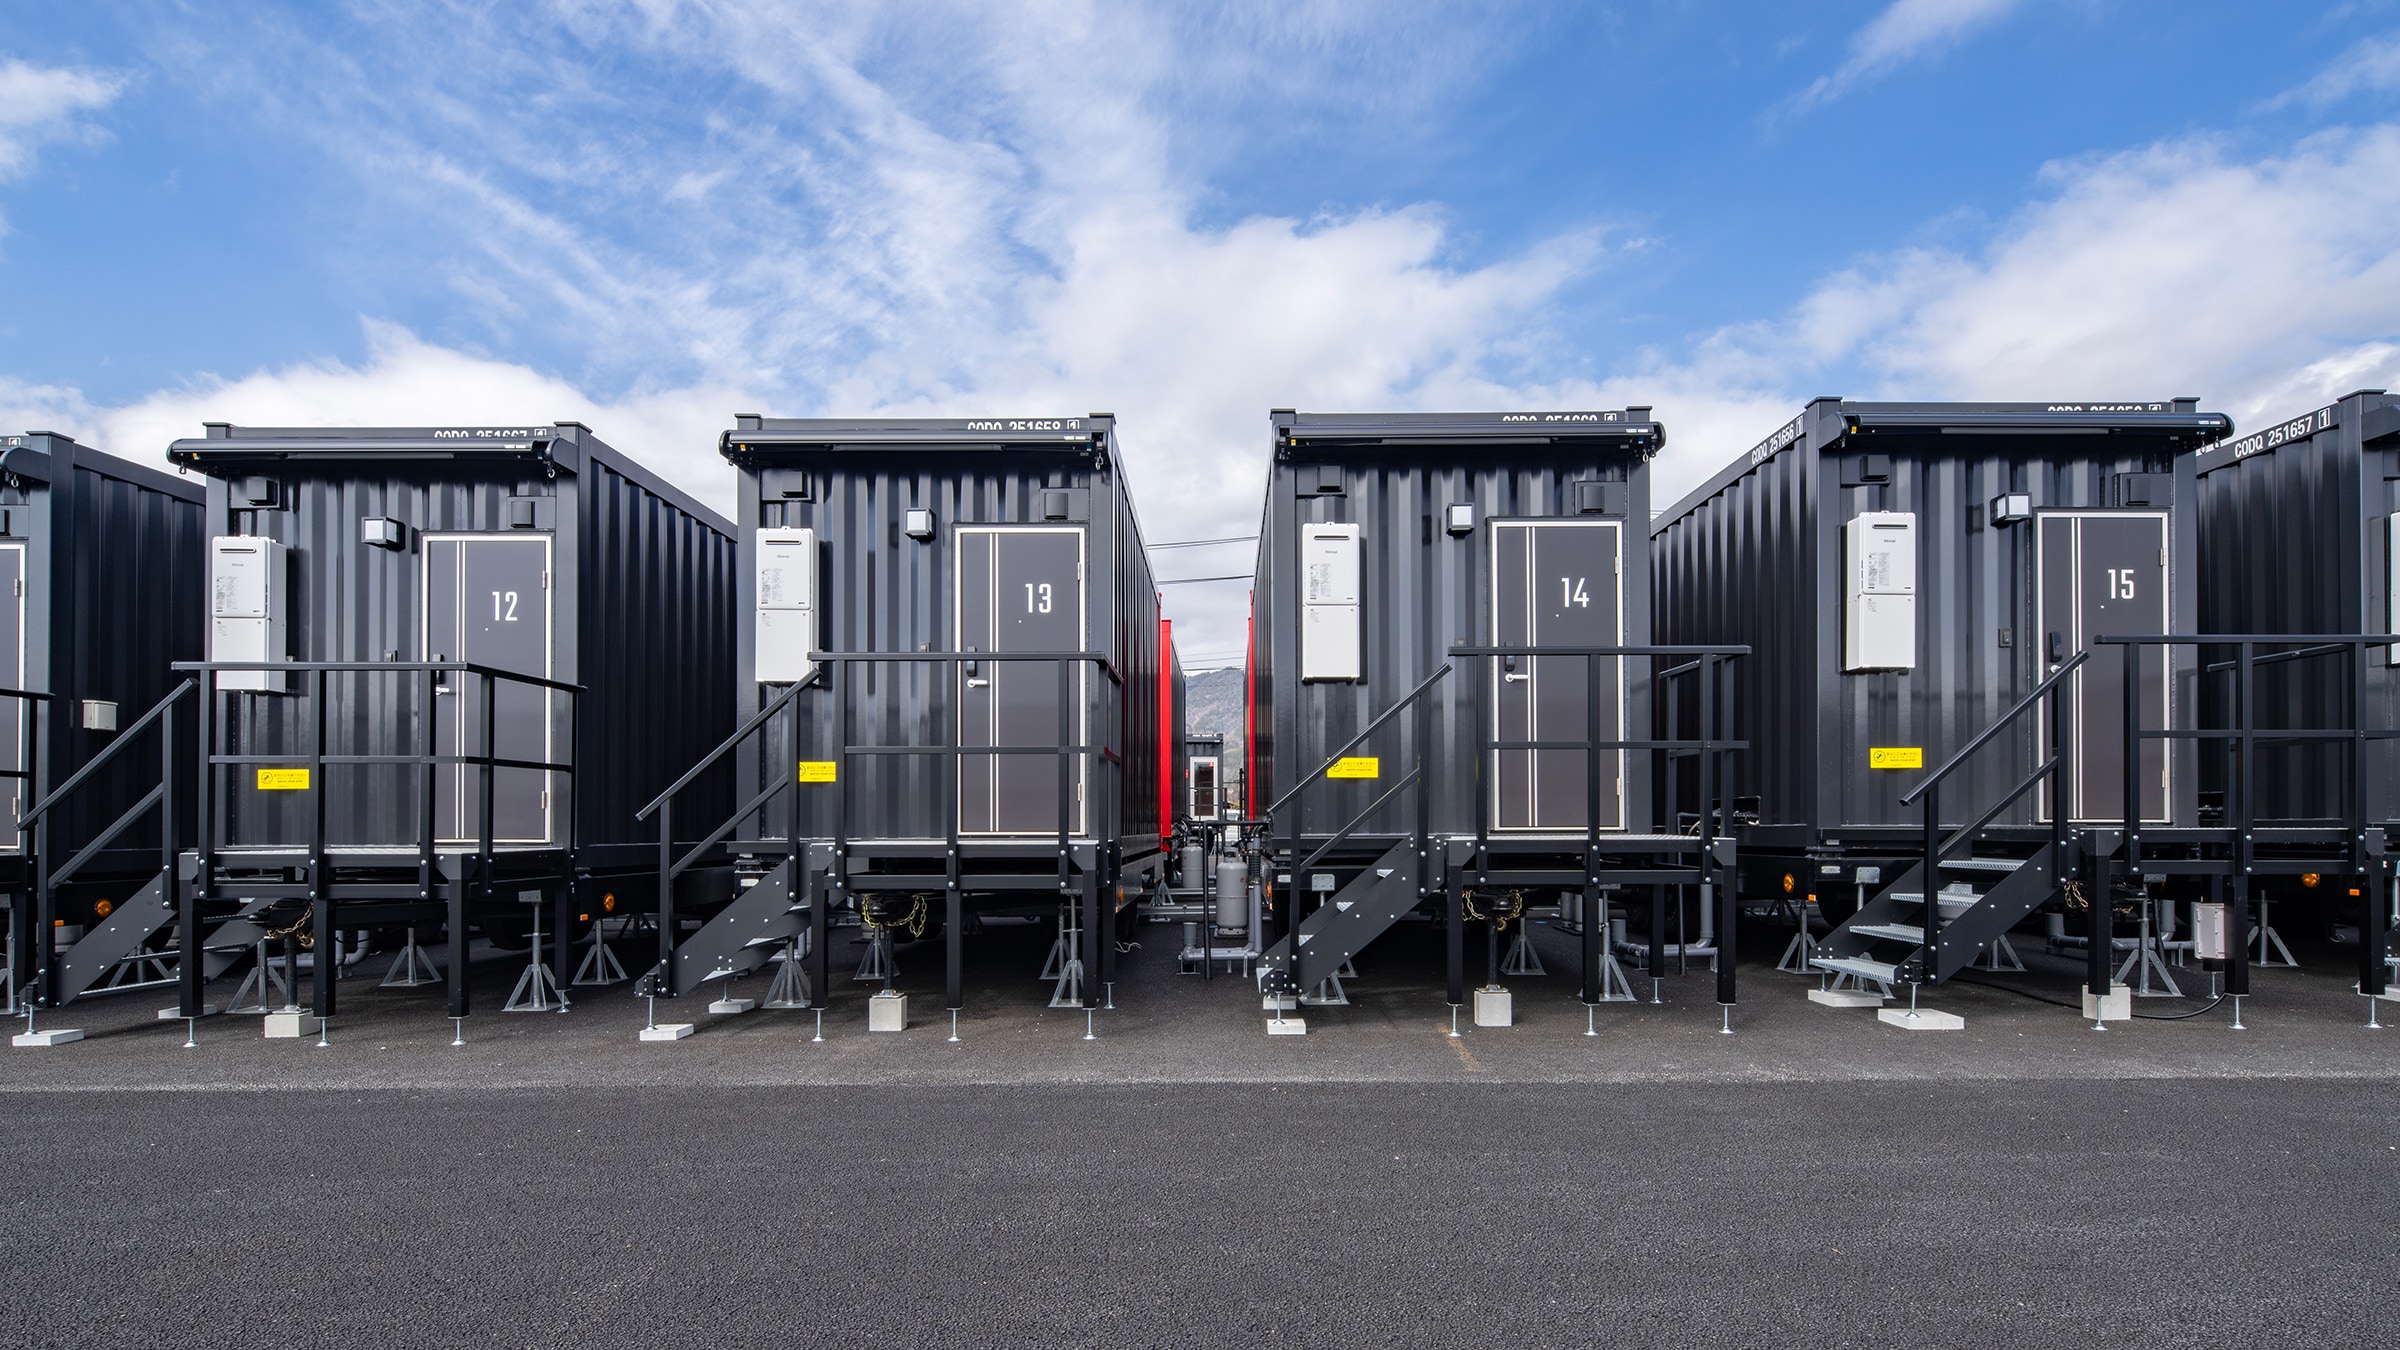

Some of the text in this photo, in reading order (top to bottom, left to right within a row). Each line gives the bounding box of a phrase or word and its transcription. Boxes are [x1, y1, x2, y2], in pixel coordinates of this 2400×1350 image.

[1769, 423, 1794, 453] 251656
[2235, 436, 2264, 458] CODQ
[2267, 415, 2313, 447] 251657
[1025, 583, 1052, 613] 13
[1561, 577, 1590, 608] 14
[2108, 569, 2134, 599] 15
[492, 591, 518, 621] 12
